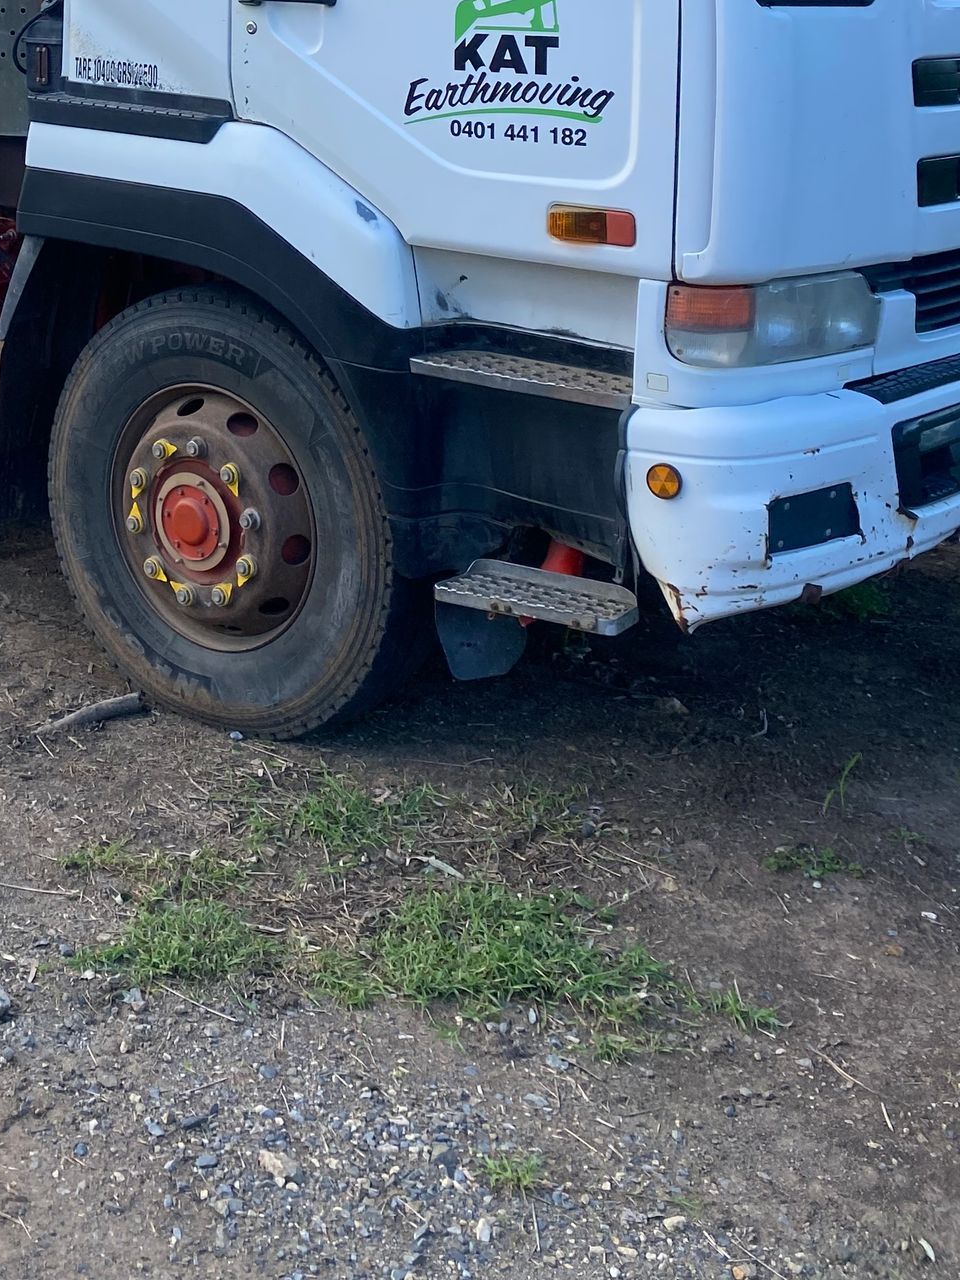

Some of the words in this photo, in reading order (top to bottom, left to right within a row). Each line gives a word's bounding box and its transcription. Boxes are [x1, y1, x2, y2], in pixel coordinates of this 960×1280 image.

[74, 56, 92, 80] TARE
[454, 33, 560, 76] KAT
[403, 71, 615, 118] Earthmoving
[449, 119, 496, 140] 0401
[503, 123, 539, 143] 441
[549, 127, 588, 147] 182
[151, 332, 246, 366] POWER
